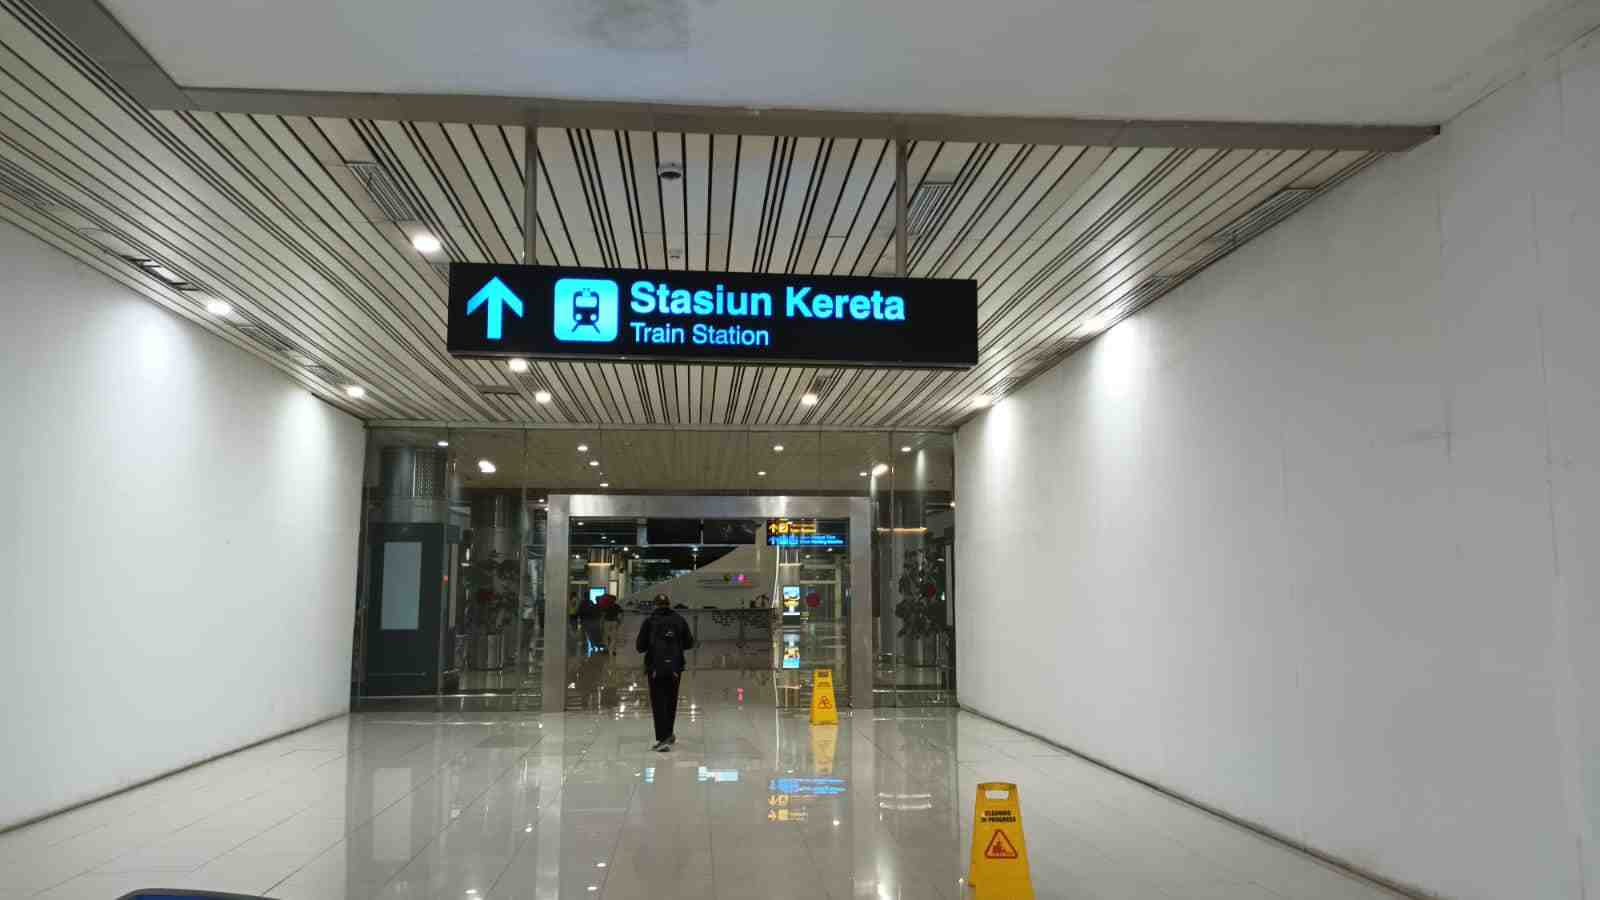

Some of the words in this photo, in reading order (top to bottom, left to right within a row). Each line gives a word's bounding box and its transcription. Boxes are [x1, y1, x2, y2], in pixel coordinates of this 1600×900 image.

[630, 280, 773, 318] Stasiun
[785, 286, 906, 321] Kereta
[630, 321, 686, 344] Train
[692, 323, 770, 347] Station
